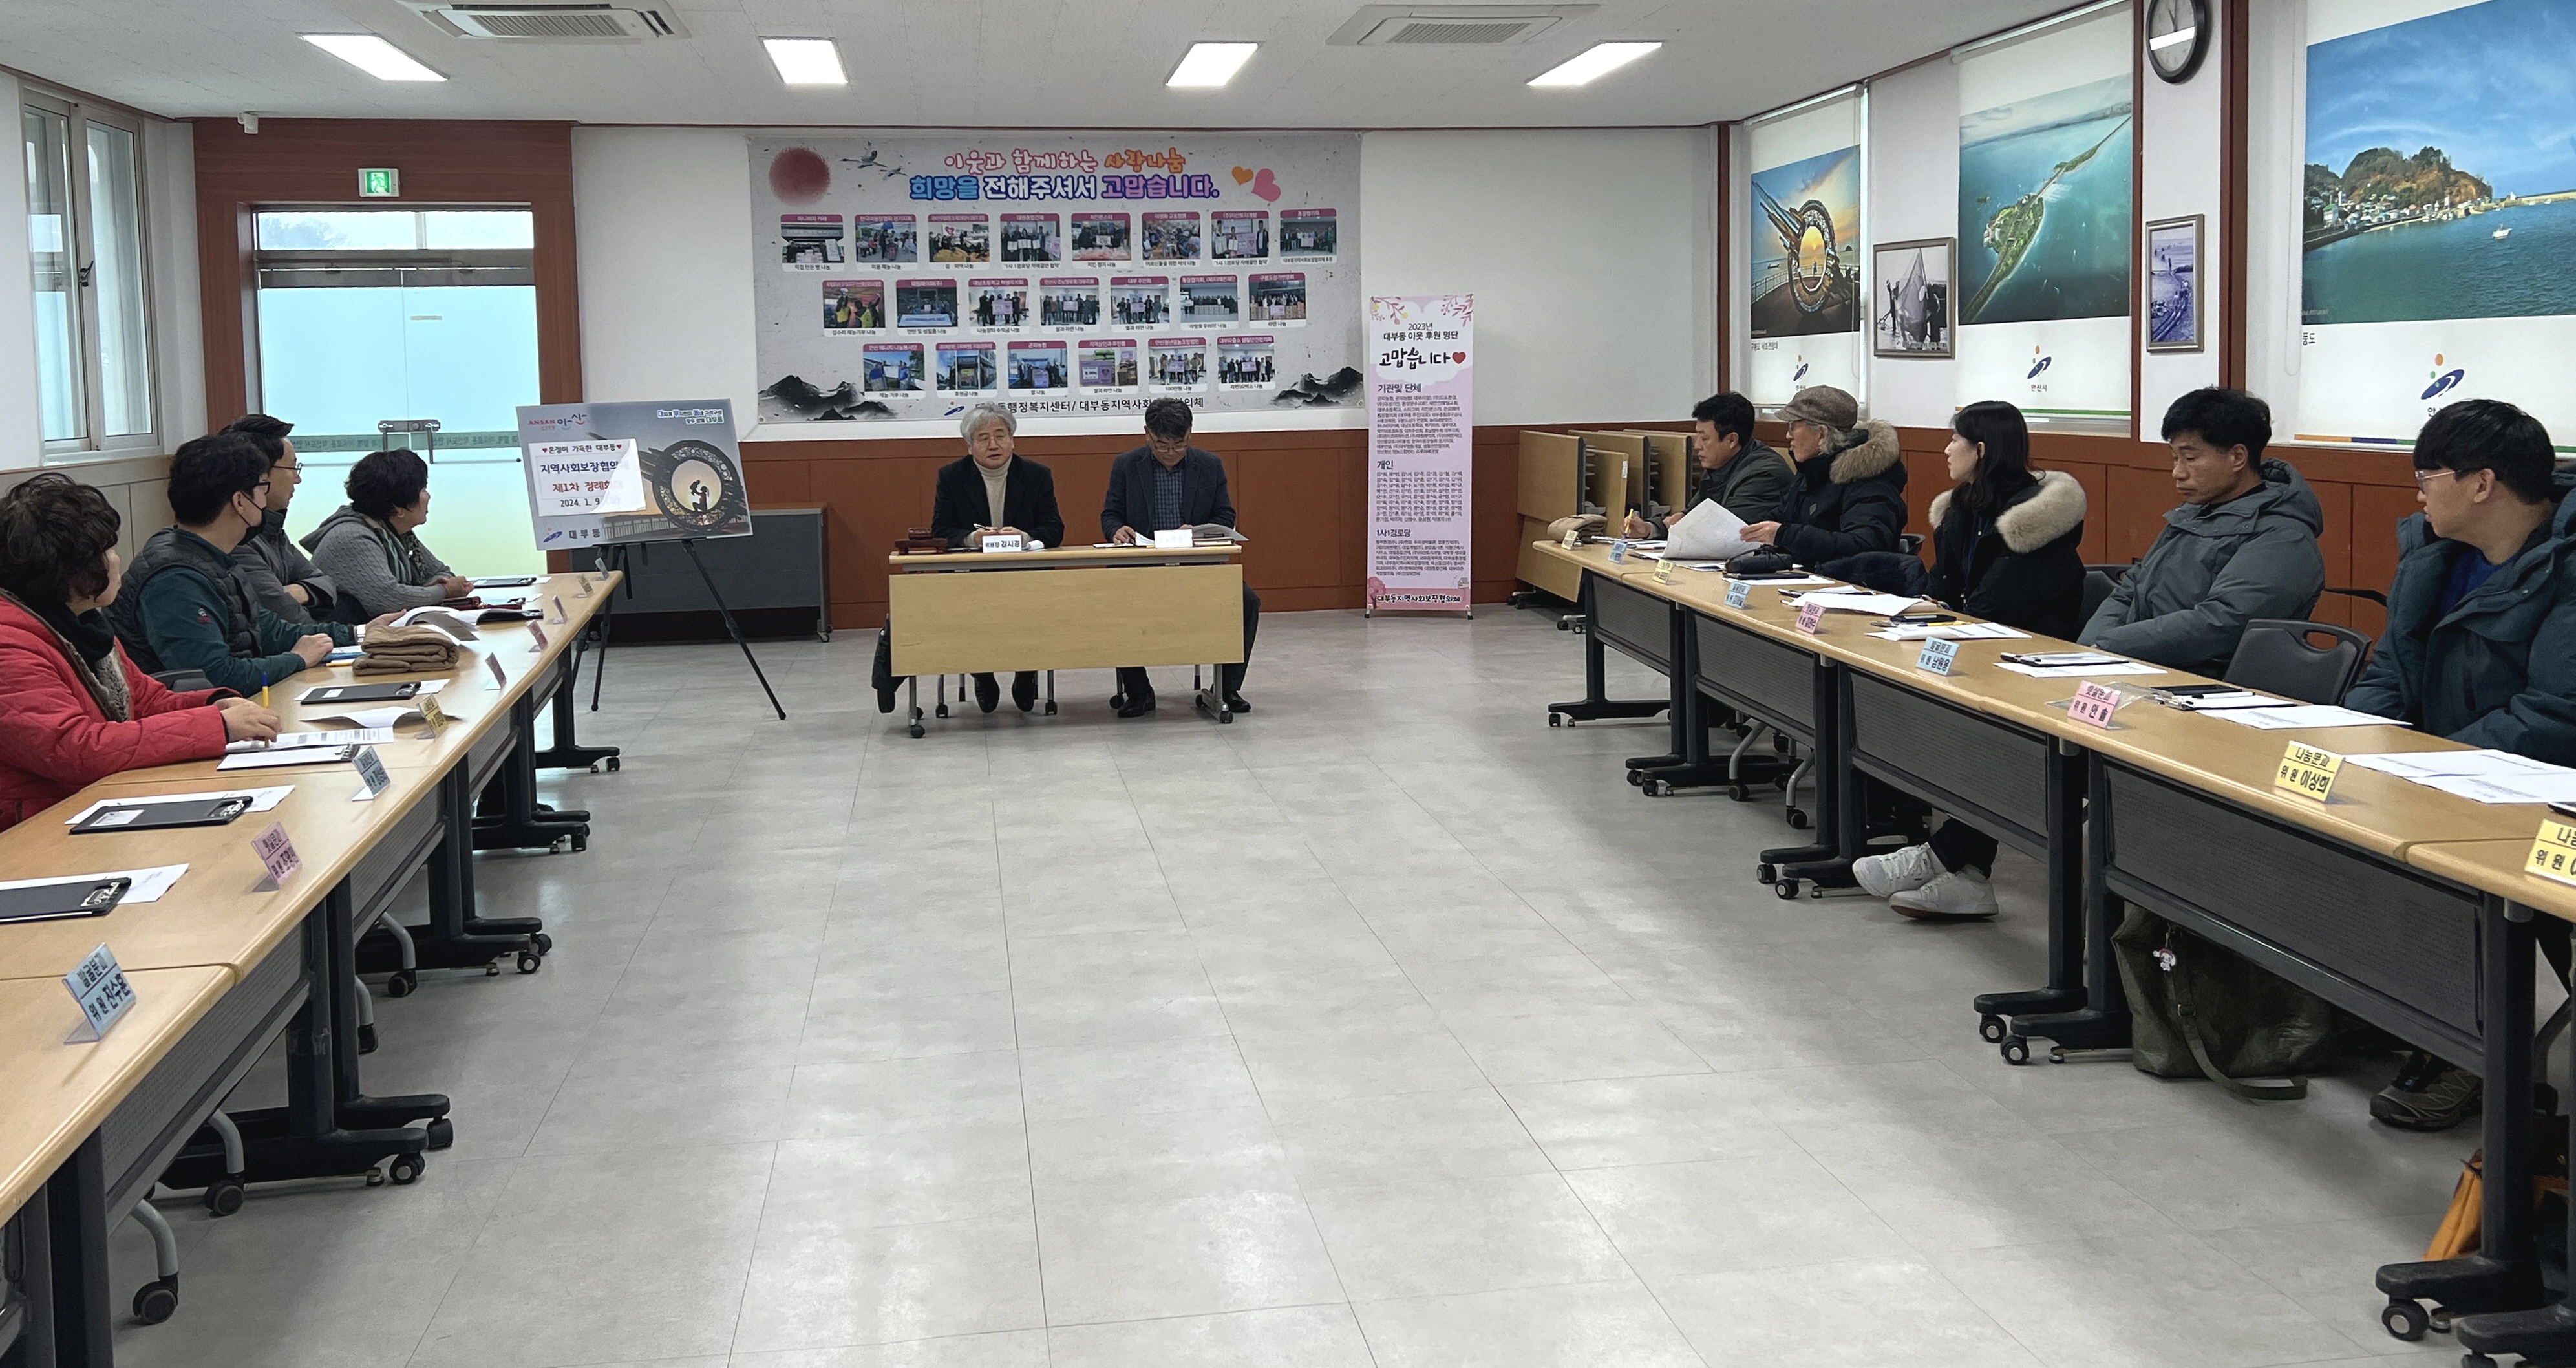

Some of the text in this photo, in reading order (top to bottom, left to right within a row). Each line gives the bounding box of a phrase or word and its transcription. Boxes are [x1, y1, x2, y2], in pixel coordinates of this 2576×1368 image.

[944, 147, 1186, 175] 이웃과 함께하는 사랑나눔
[910, 174, 1220, 200] 희망을 전해주셔서 고맙습니다.
[1407, 322, 1434, 331] 2023년
[1383, 330, 1459, 341] 대부동 이웃 후원 명단
[2303, 332, 2315, 346] 풍도
[1379, 347, 1451, 370] 고맙습니다
[1405, 383, 1421, 393] 단체
[975, 397, 1204, 414] 행정복지센터/ 대부동지역사회의체
[549, 444, 616, 454] 온정이 가득한 대부동
[540, 461, 619, 475] 지역사회보장협의
[1376, 460, 1394, 470] 개인
[553, 480, 611, 493] 제1차 정례회
[560, 498, 582, 508] 2024.
[1376, 529, 1411, 538] 1사1경로당
[1376, 593, 1462, 604] 대부동지역사회보장협의체
[2295, 747, 2330, 767] 나눔분과
[2300, 770, 2331, 794] 이상희
[76, 952, 108, 989] 발굴분과
[102, 973, 131, 1009] 진수훈
